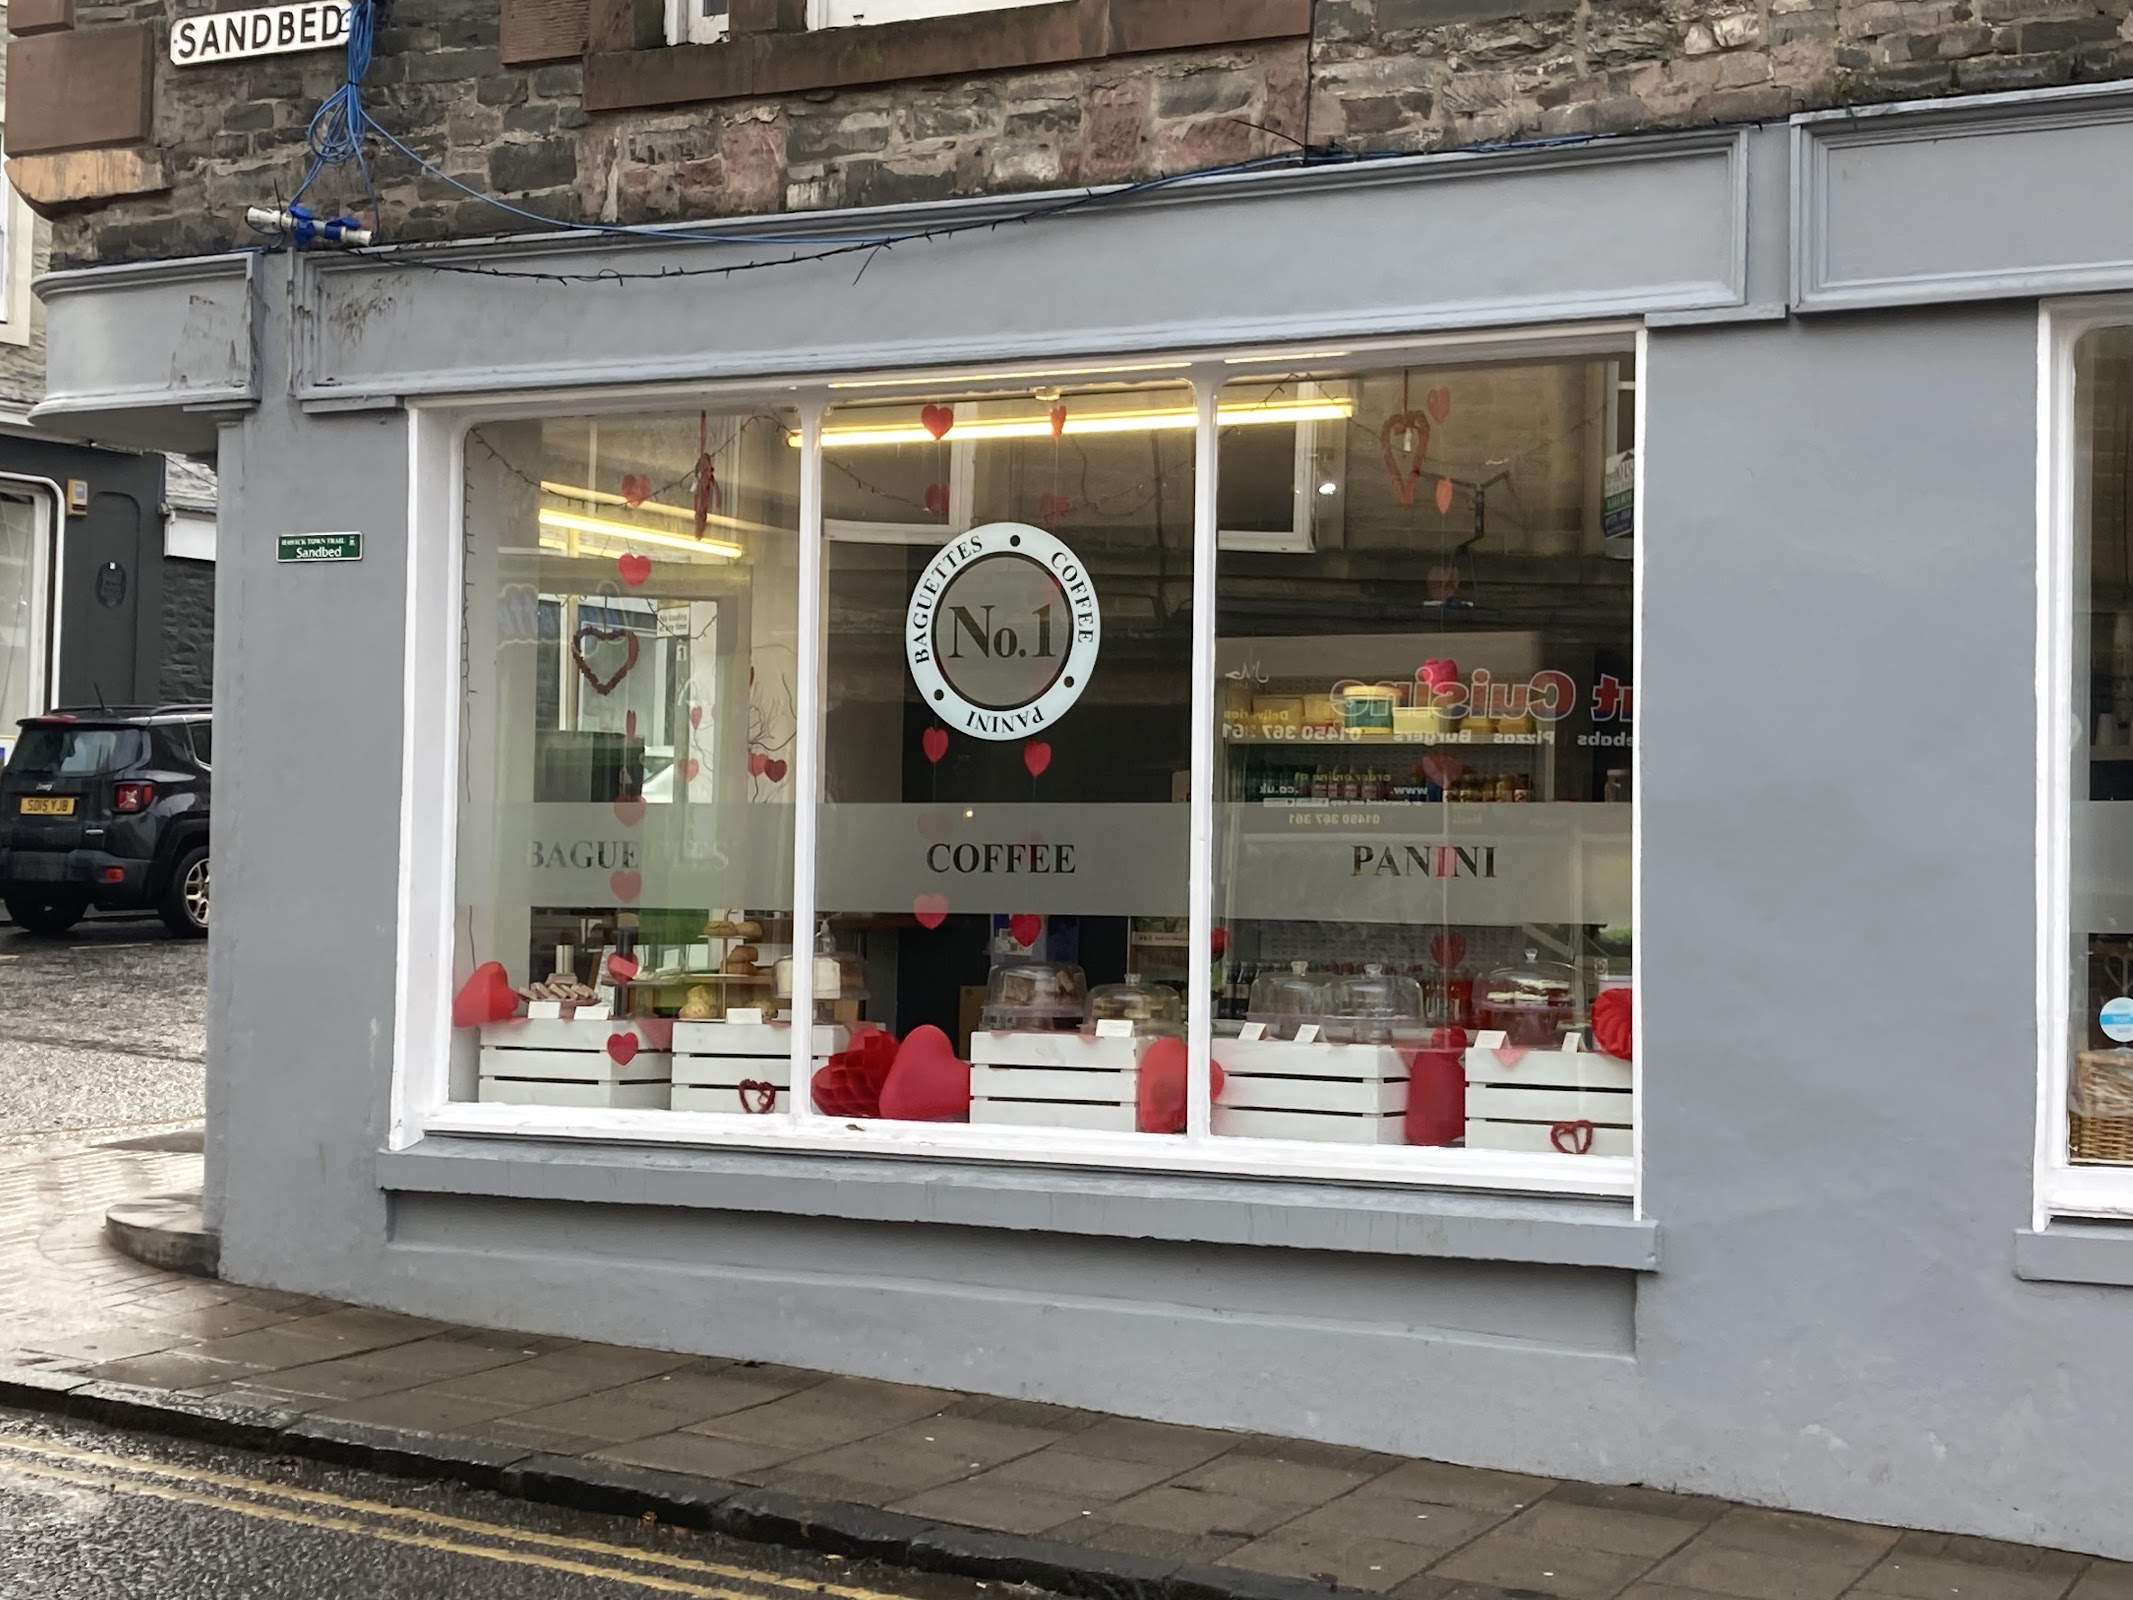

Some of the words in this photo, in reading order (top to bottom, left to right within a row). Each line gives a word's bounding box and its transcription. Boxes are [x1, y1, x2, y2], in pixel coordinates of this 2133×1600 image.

[178, 5, 343, 58] SANDBED
[296, 546, 342, 558] Sandbed
[913, 535, 983, 663] BAGUETTES
[1051, 552, 1094, 643] COFFEE
[948, 603, 1056, 658] No.1
[679, 647, 685, 660] 1
[966, 705, 1045, 733] PANINI
[51, 800, 69, 812] YJB
[927, 843, 1076, 874] COFFEE
[1351, 845, 1497, 879] PANINI
